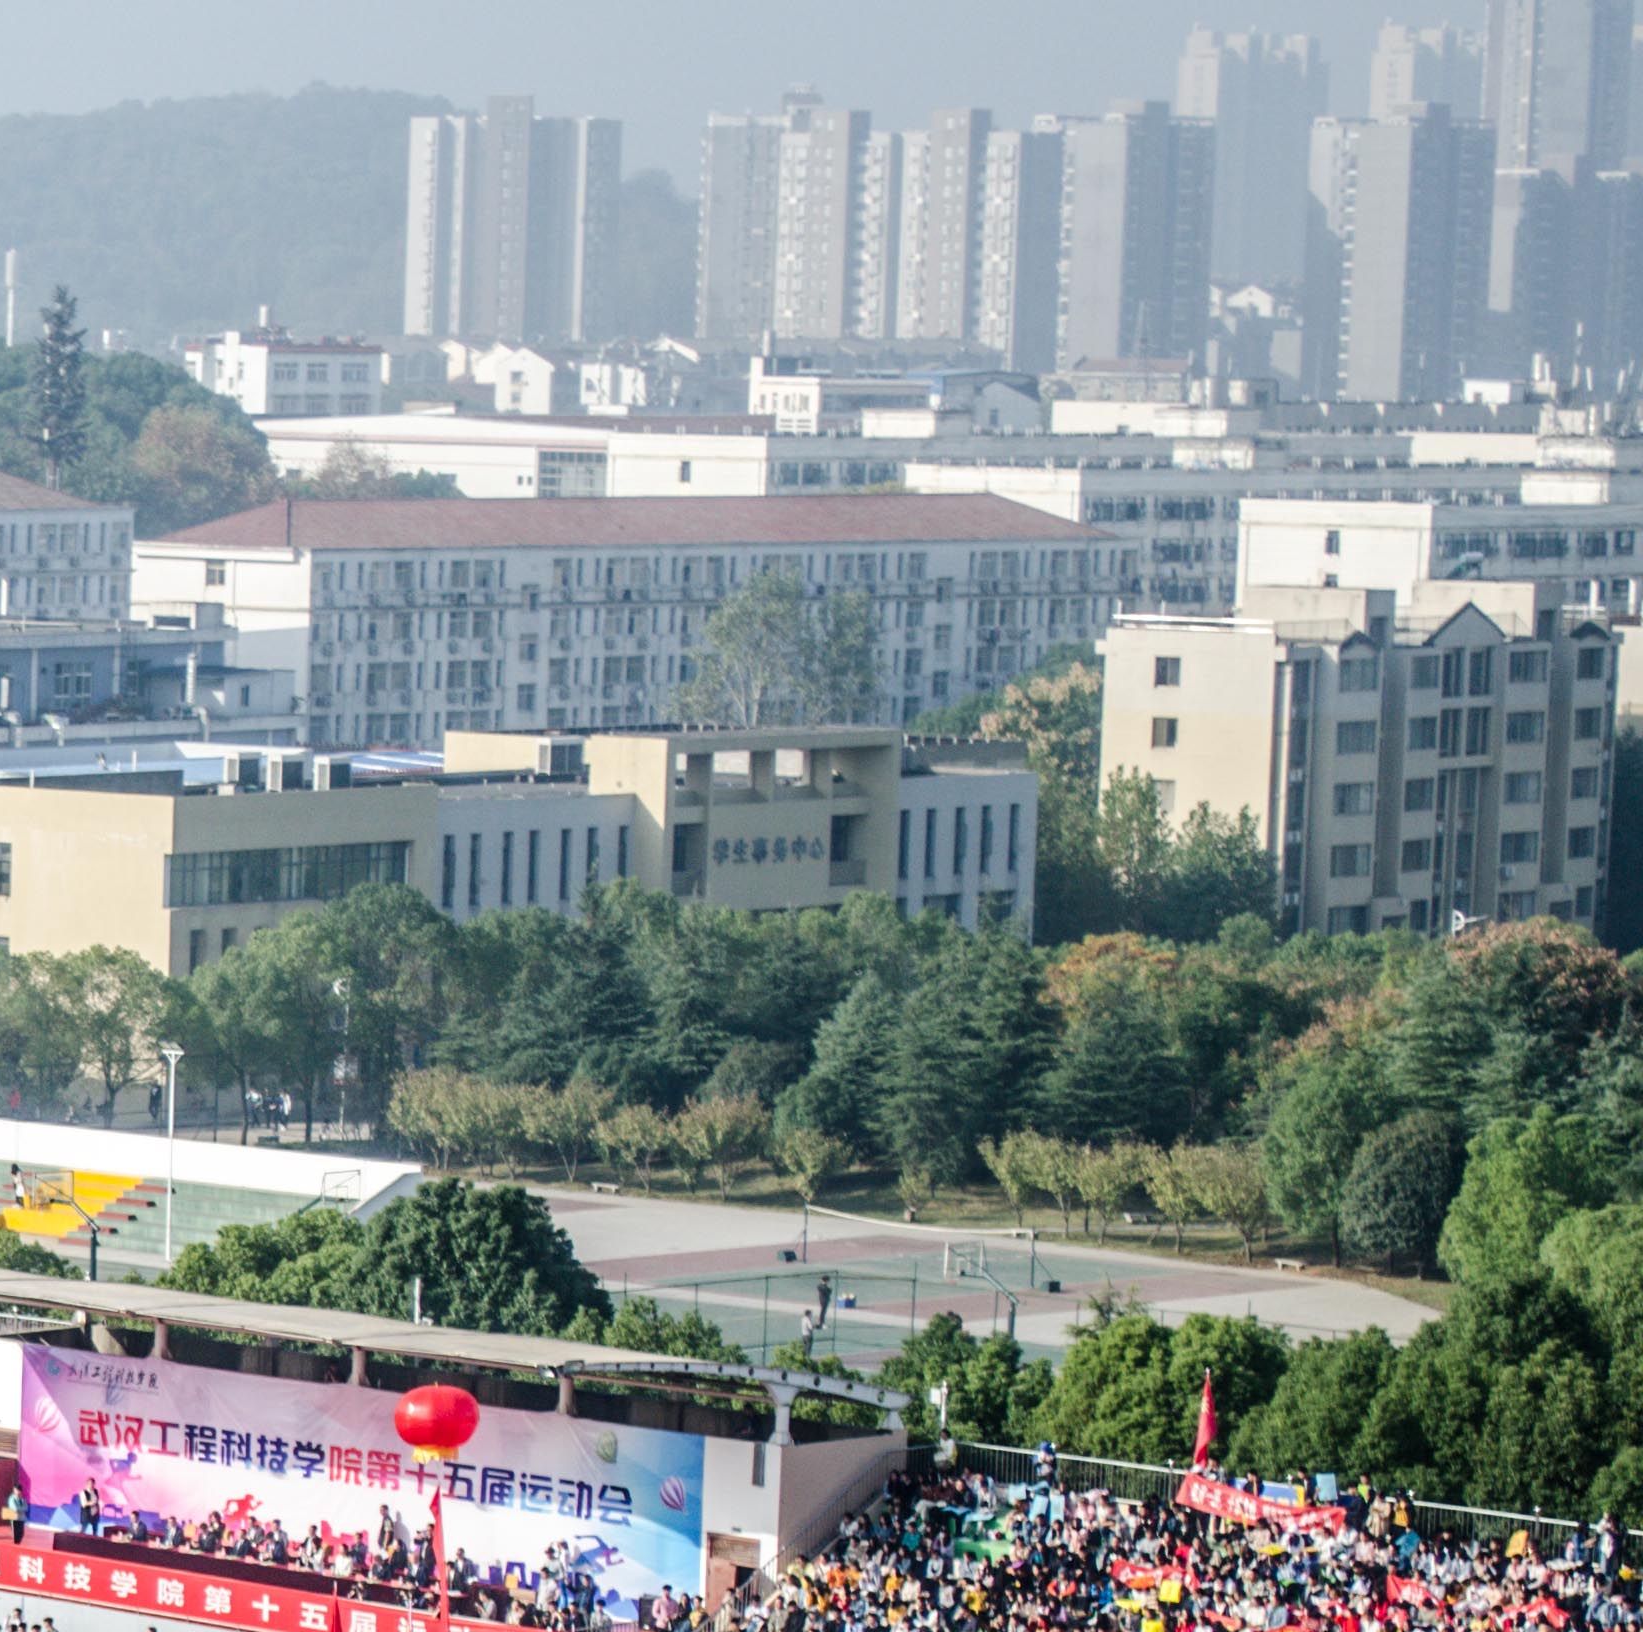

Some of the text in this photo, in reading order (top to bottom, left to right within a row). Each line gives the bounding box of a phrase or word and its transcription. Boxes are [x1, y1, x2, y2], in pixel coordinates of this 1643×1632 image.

[713, 835, 825, 864] 学生事务中心
[78, 1408, 634, 1528] 武汉工程科技学院第十五届运动会
